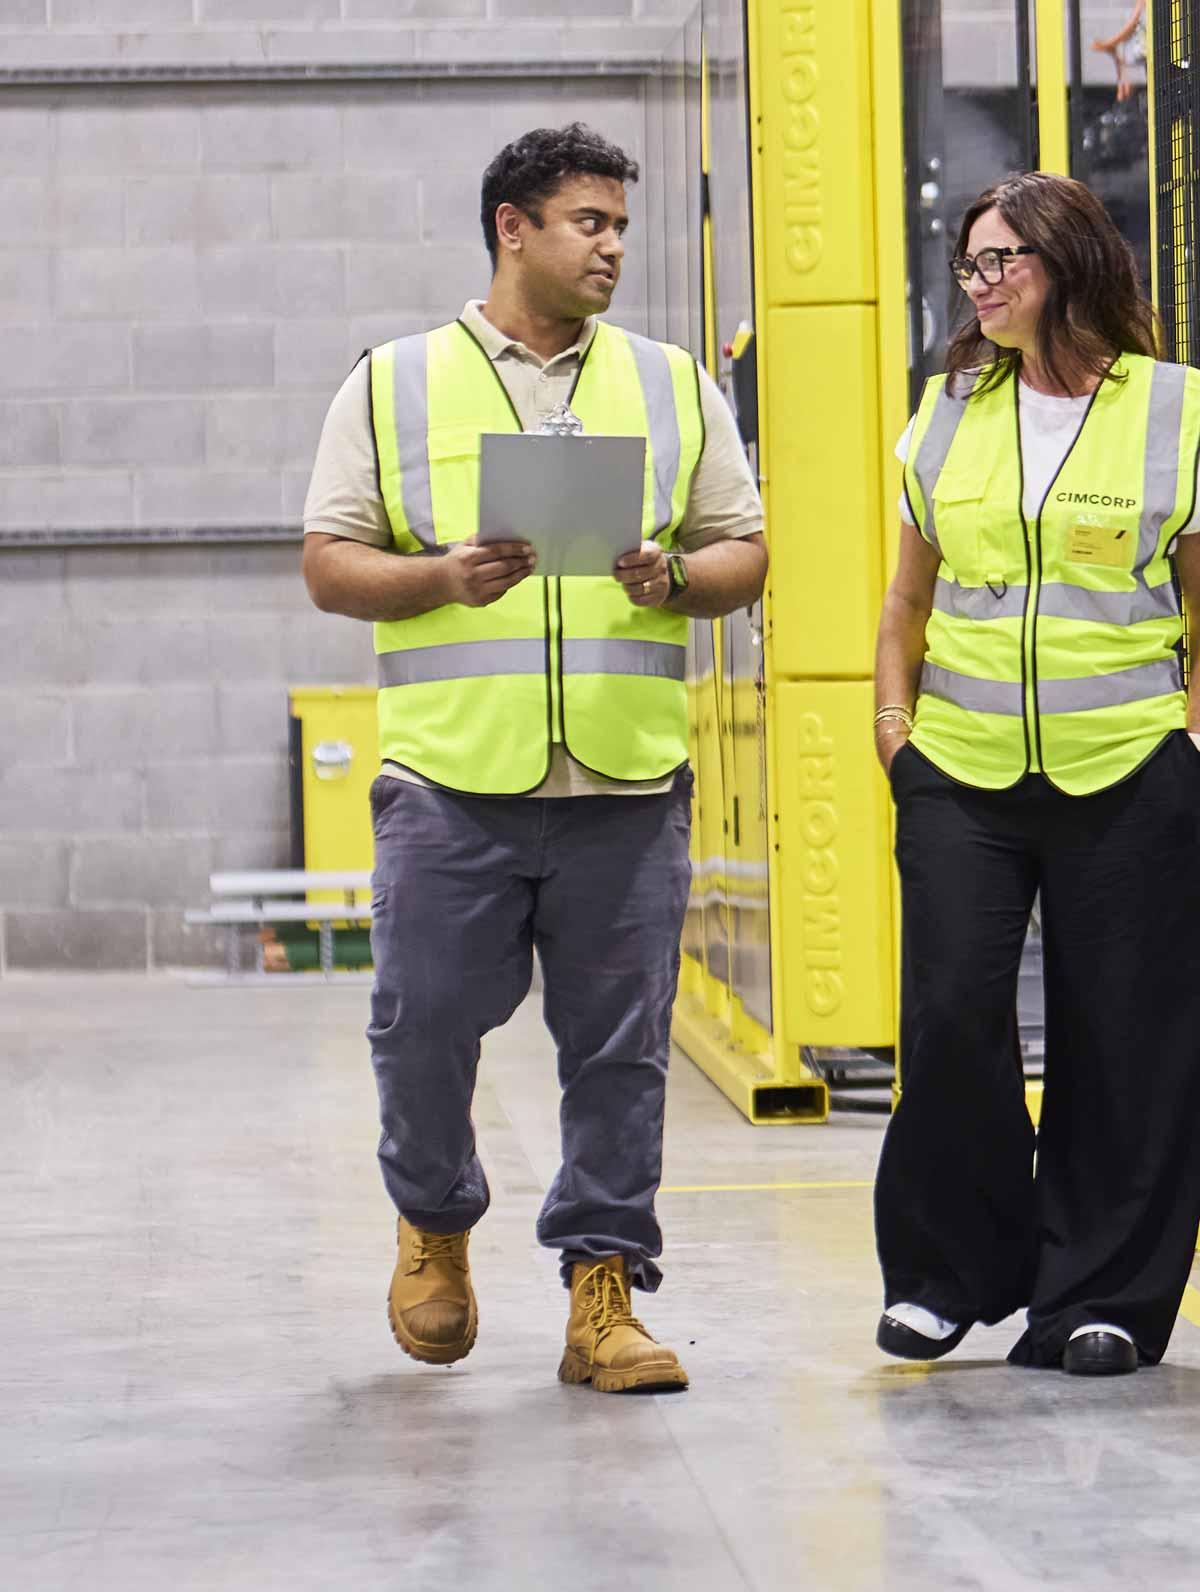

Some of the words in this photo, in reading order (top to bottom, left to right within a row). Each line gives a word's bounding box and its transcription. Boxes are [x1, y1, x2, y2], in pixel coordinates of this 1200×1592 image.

[780, 0, 823, 275] CIMCOR
[1056, 492, 1137, 509] CIMCORP
[799, 711, 842, 1017] CIMCORP
